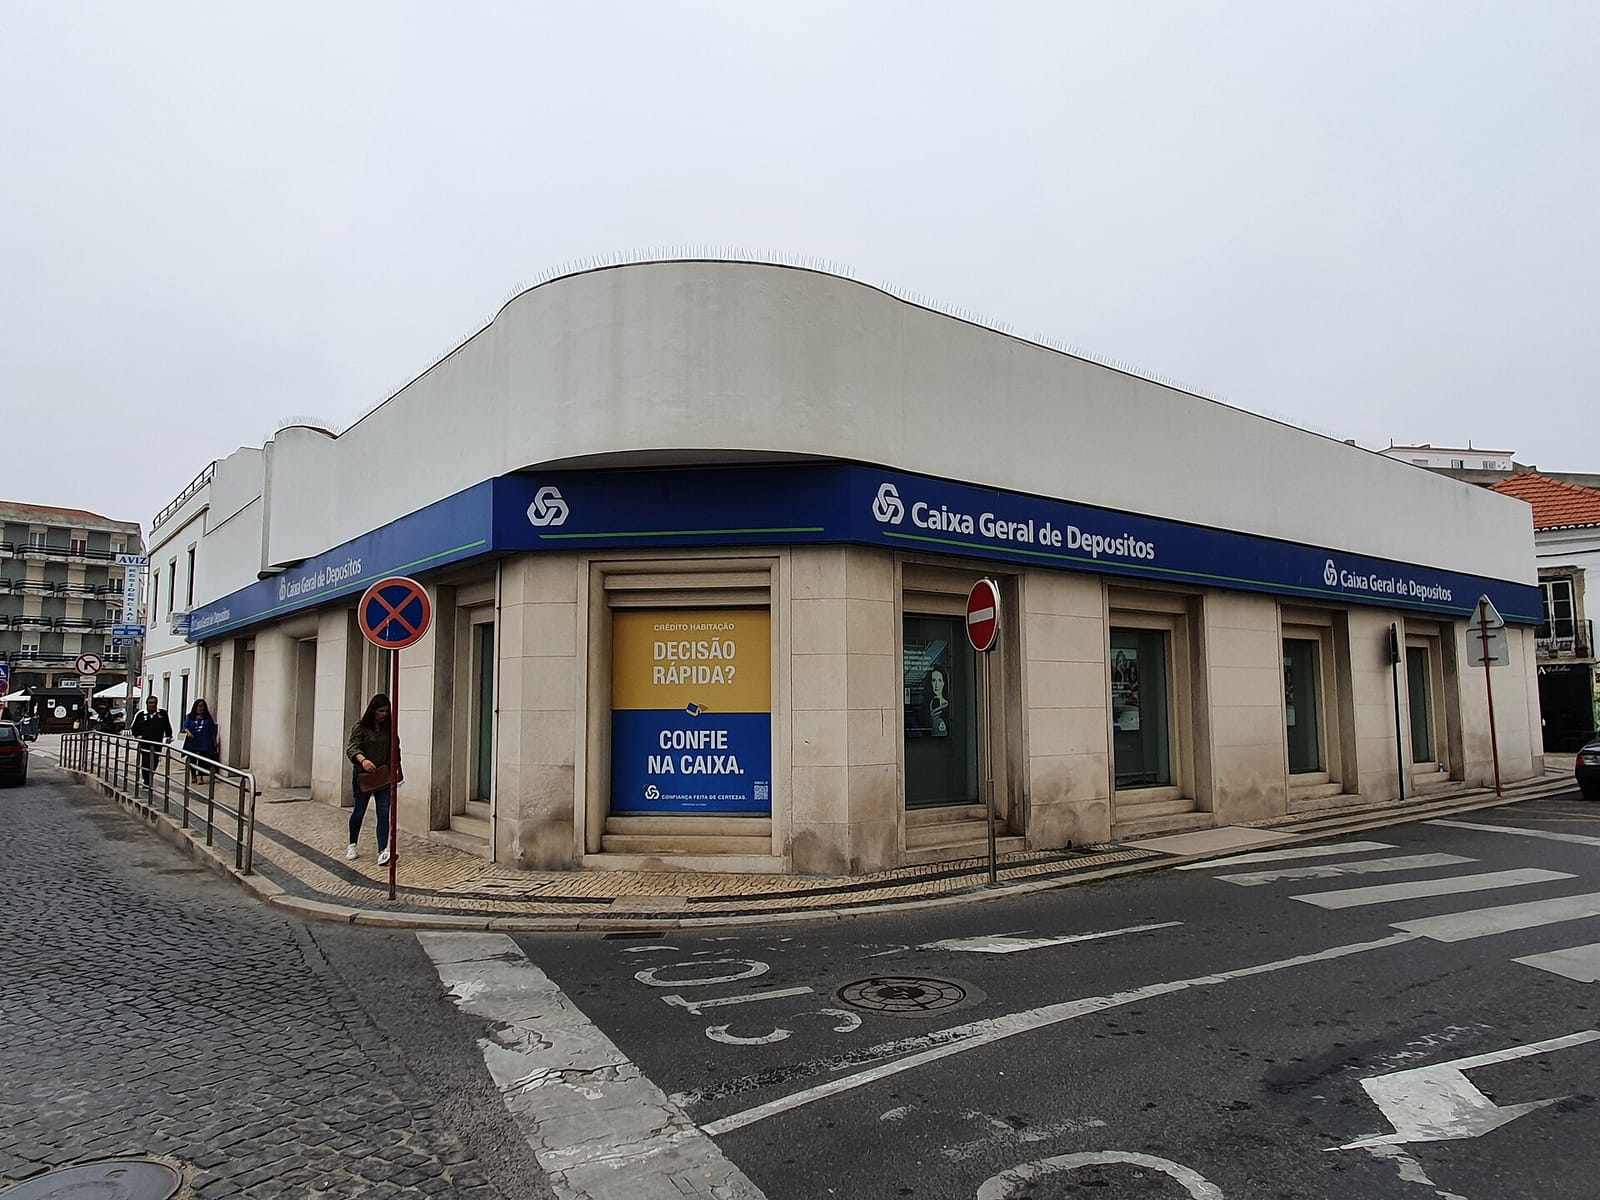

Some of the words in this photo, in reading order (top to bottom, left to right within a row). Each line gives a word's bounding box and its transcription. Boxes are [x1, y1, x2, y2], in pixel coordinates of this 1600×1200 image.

[911, 501, 974, 535] Caixa
[979, 512, 1034, 543] Geral
[1039, 522, 1062, 547] de
[119, 556, 147, 564] AVIZ
[286, 581, 300, 598] Caixa
[301, 572, 316, 594] Geral
[317, 569, 325, 588] de
[1340, 569, 1369, 590] Caixa
[1369, 574, 1395, 594] Geral
[1396, 578, 1408, 596] de
[654, 623, 688, 632] CRÉDITO
[690, 622, 735, 632] HABITAÇÃO
[653, 636, 736, 661] DECISÃO
[653, 661, 736, 685] RÁPIDA?
[659, 730, 728, 750] CONFIE
[647, 756, 675, 775] NA
[680, 755, 744, 775] CAIXA.
[661, 793, 692, 801] CONFIANÇA
